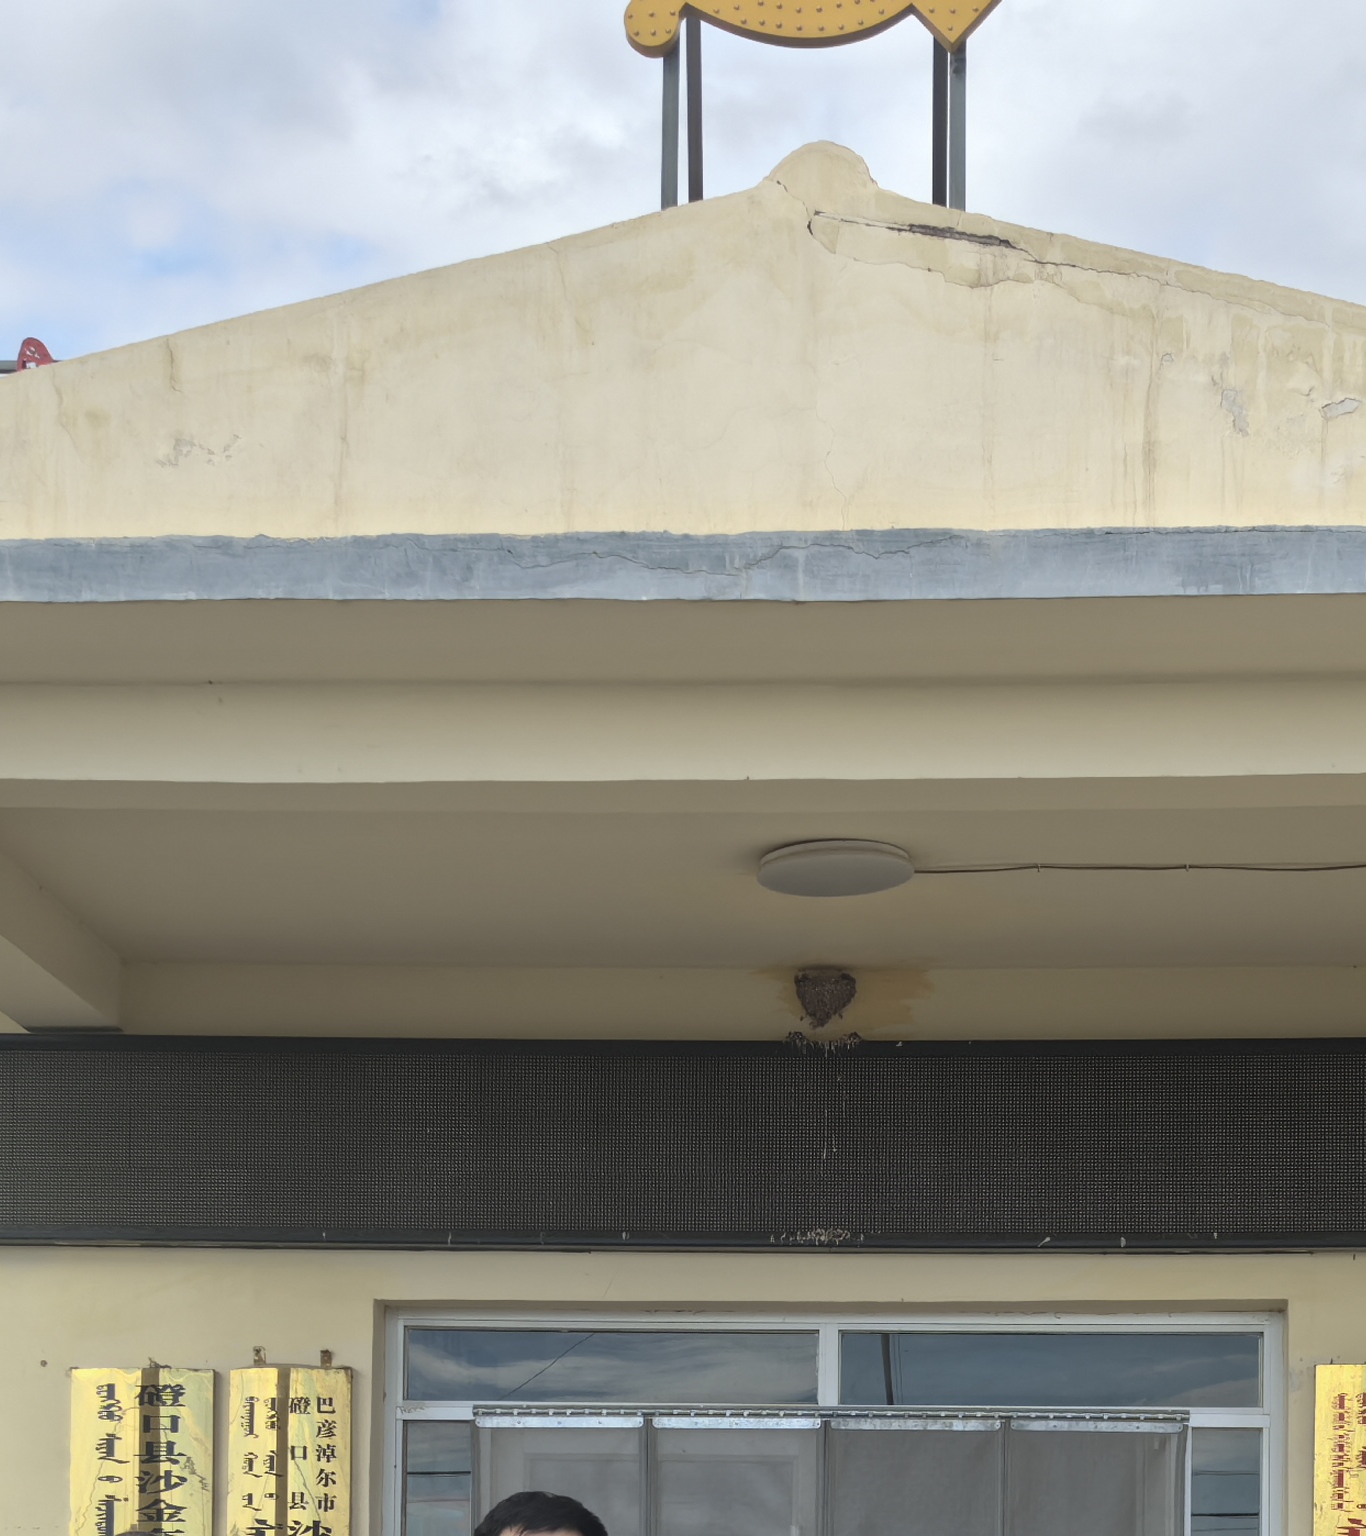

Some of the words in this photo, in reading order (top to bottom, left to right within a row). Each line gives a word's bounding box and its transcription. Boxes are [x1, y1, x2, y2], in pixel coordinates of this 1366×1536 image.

[288, 1396, 311, 1511] 磴口县
[316, 1396, 337, 1513] 巴彦淖尔市
